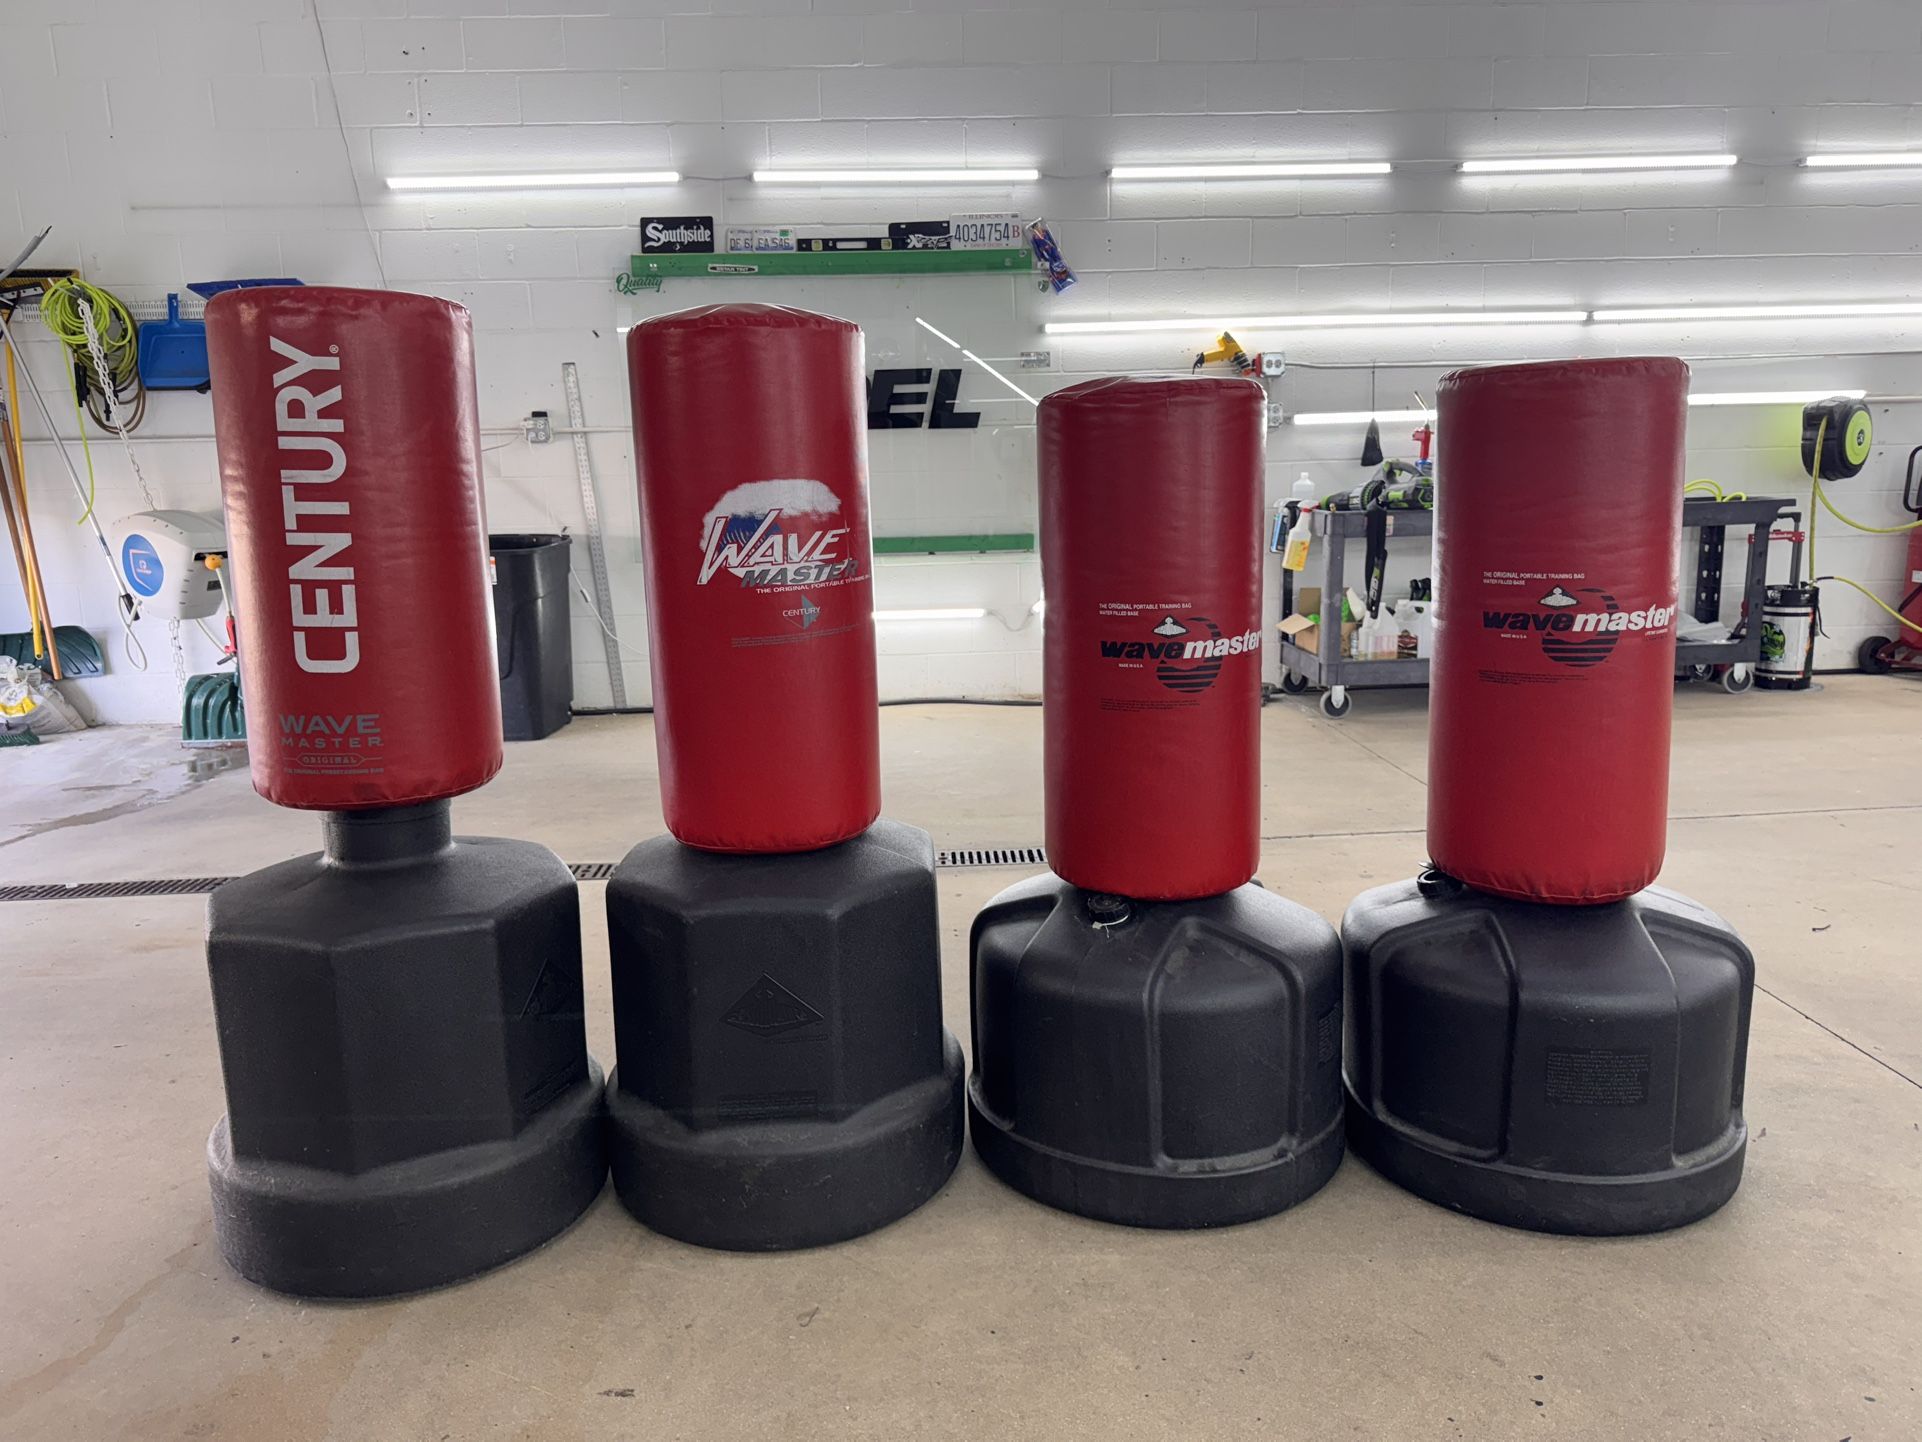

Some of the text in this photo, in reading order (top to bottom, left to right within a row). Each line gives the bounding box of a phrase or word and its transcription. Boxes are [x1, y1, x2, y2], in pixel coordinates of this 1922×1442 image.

[644, 223, 712, 248] Southside
[954, 223, 1010, 242] 4034754
[1012, 224, 1021, 239] B
[866, 368, 981, 429] EL
[697, 508, 851, 585] WAVE
[741, 559, 859, 587] MASTER
[1493, 571, 1519, 579] ORIGINAL
[773, 584, 809, 593] ORIGINAL
[782, 606, 821, 618] CENTURY
[1483, 603, 1676, 632] wavemaster
[1100, 629, 1262, 660] wavemaster
[279, 713, 381, 735] WAVE
[281, 736, 384, 749] MASTER
